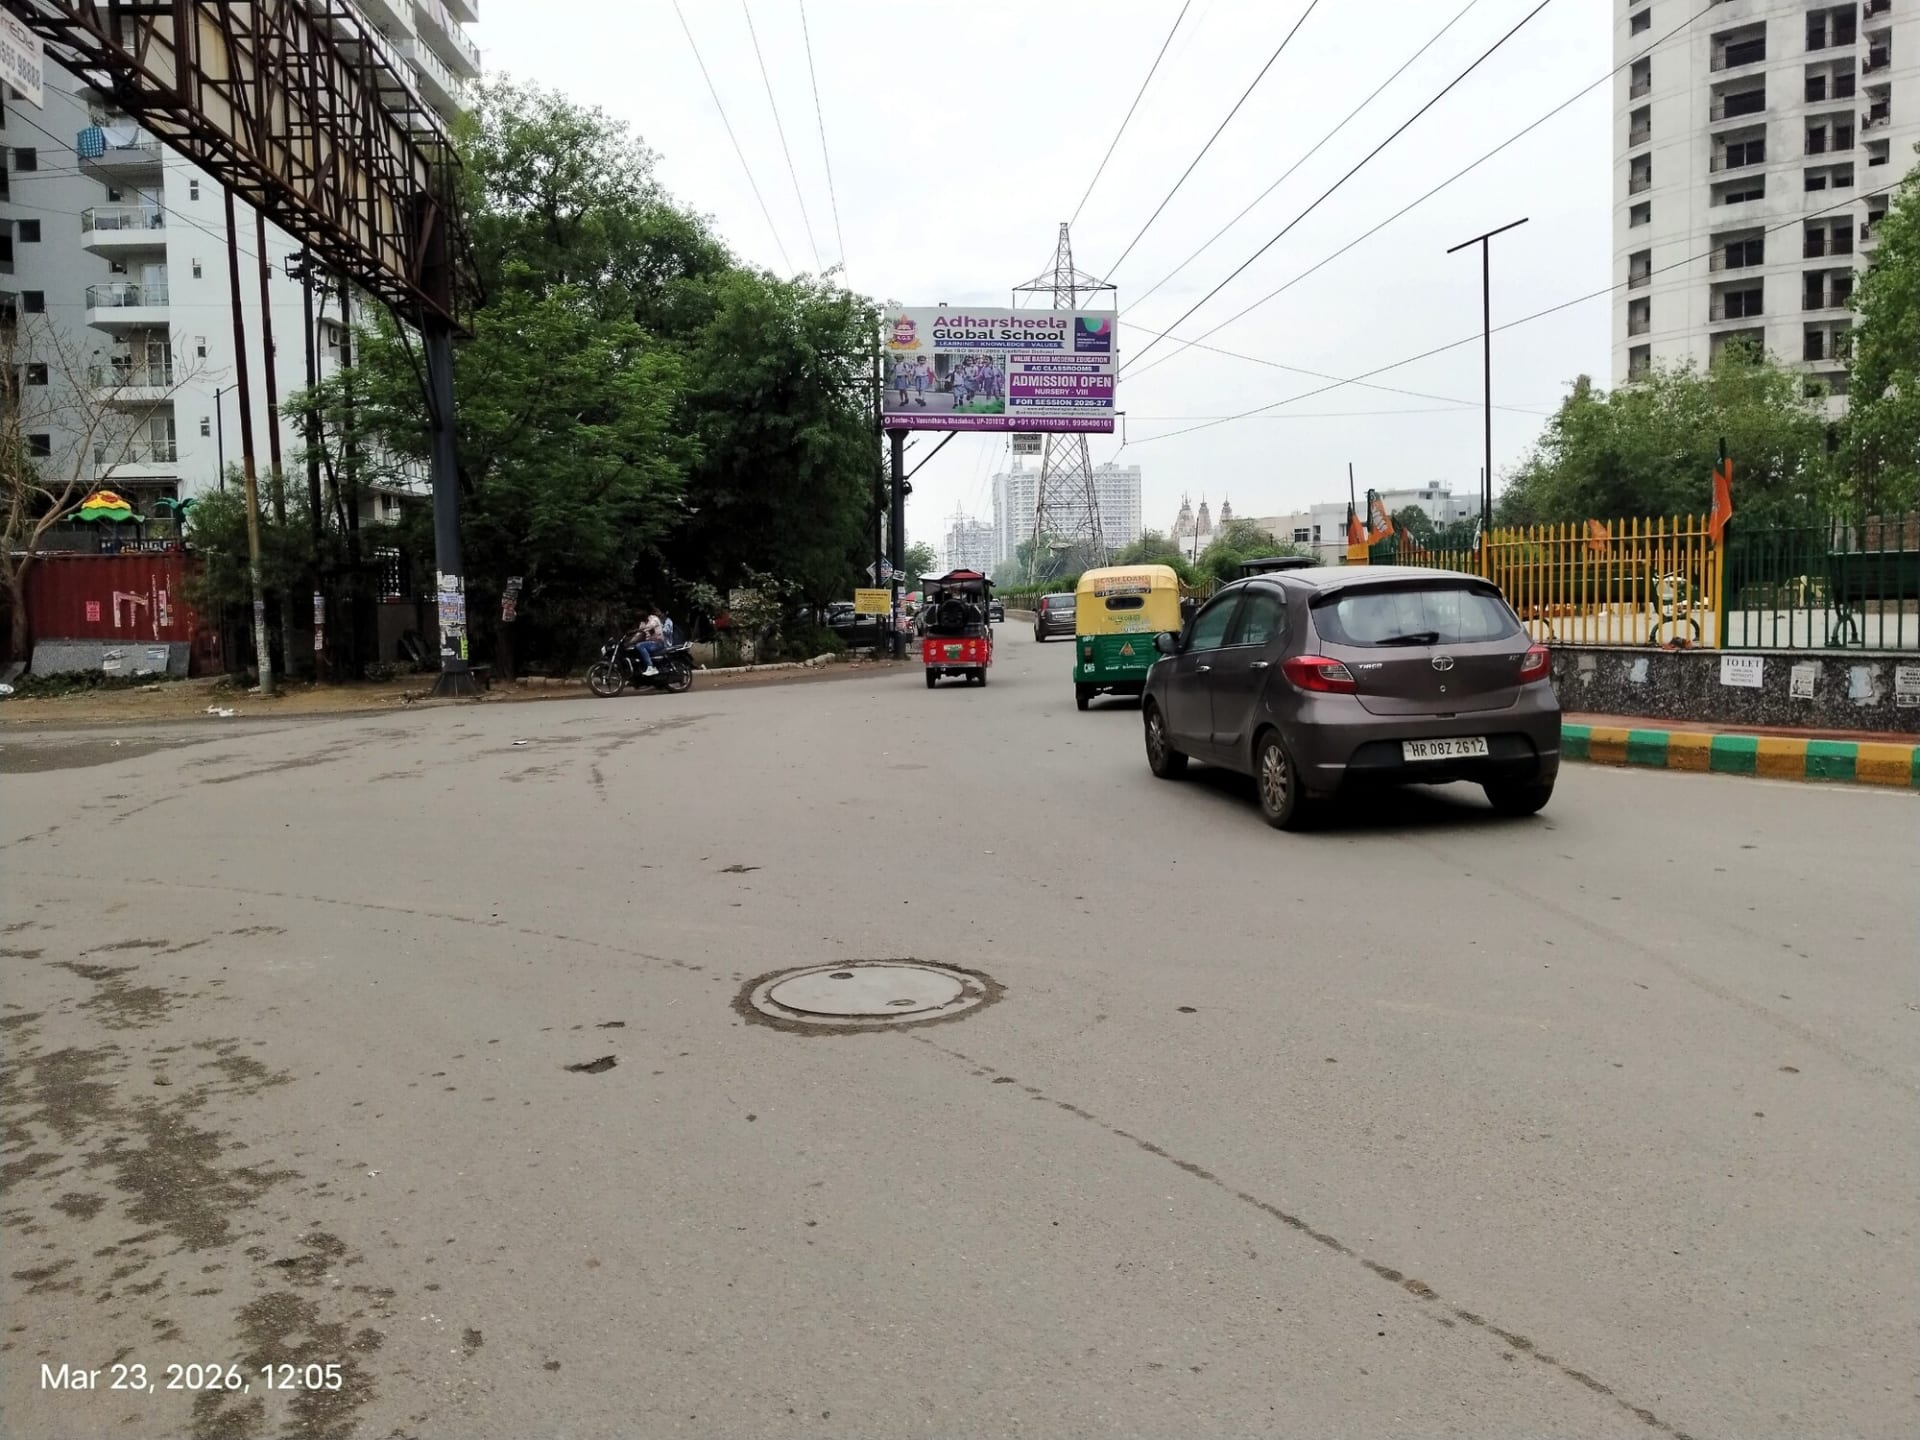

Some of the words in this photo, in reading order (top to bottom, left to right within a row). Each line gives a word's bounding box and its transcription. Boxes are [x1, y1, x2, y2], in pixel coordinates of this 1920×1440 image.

[933, 315, 1067, 328] Adharsheela
[932, 329, 994, 340] Global
[1000, 329, 1065, 341] School
[1012, 375, 1077, 387] ADMISSION
[1080, 376, 1112, 388] OPEN
[1726, 658, 1739, 667] TO
[1741, 659, 1760, 668] LET
[1411, 742, 1428, 757] HR
[1430, 742, 1452, 755] 08Z
[1455, 740, 1486, 753] 2612
